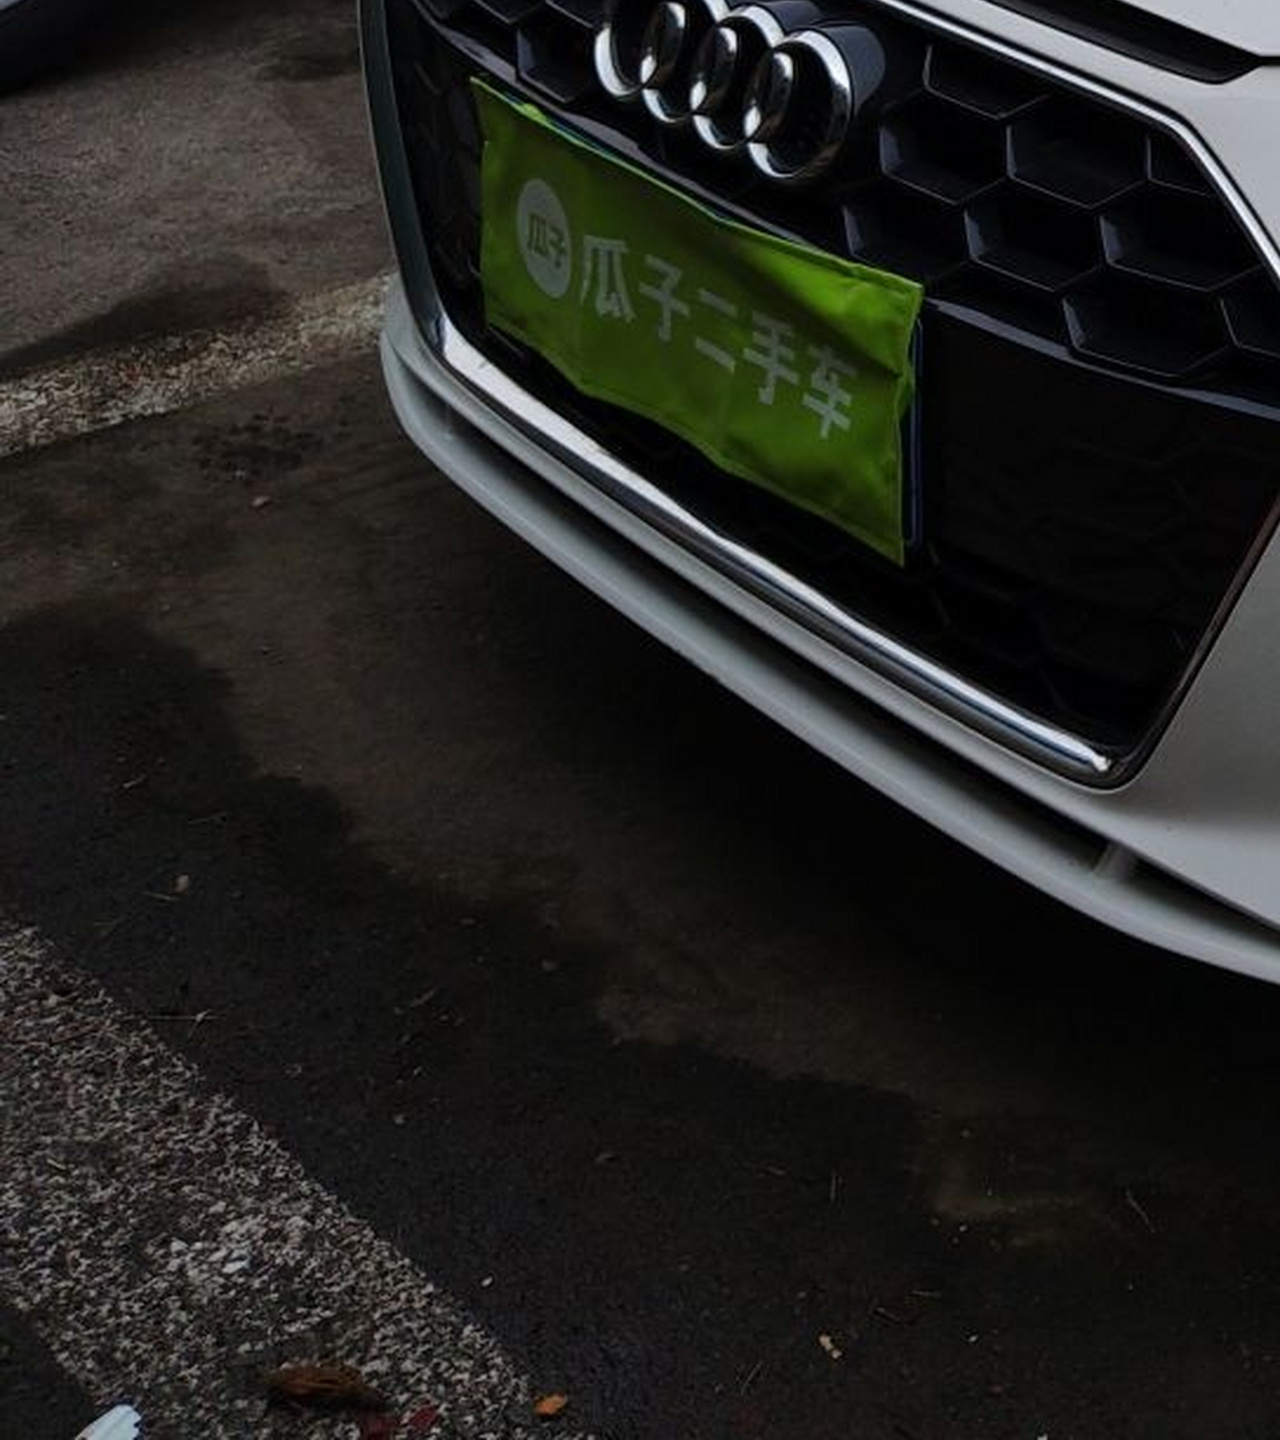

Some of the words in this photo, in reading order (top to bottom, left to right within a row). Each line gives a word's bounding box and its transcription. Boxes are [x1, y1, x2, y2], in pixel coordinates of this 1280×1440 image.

[526, 212, 567, 270] 瓜子
[579, 234, 857, 440] 瓜子二手车
